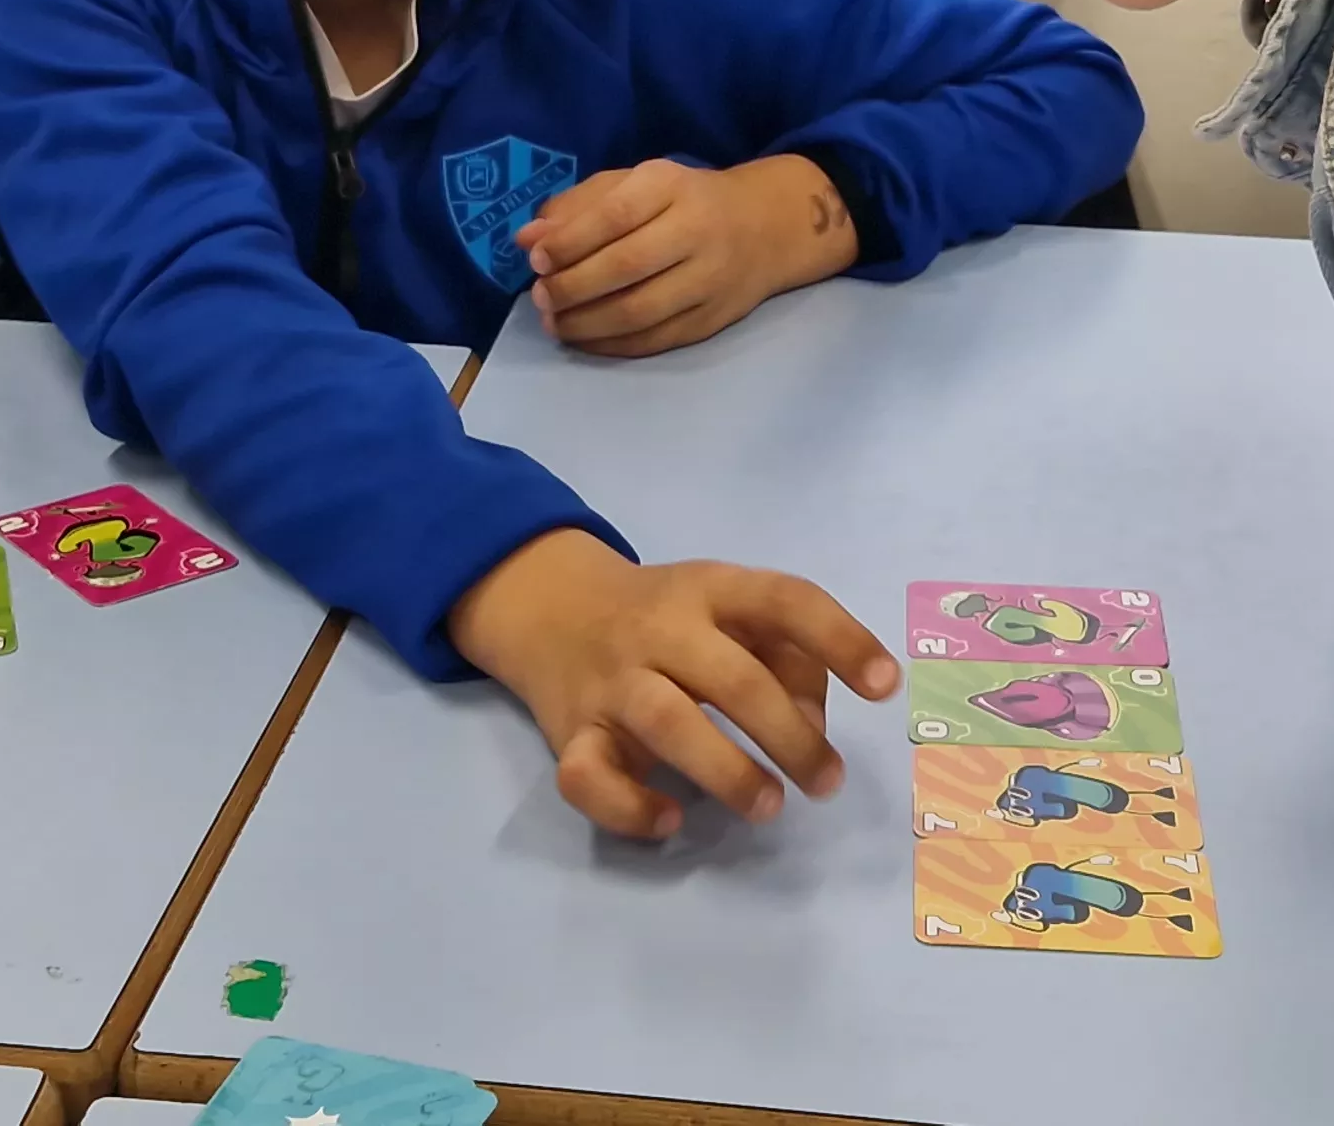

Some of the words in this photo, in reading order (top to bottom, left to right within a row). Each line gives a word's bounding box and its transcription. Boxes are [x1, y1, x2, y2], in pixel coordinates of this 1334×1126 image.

[1119, 588, 1150, 608] 2
[916, 637, 947, 655] 2
[1130, 668, 1163, 687] 0
[915, 719, 950, 739] 0
[1148, 756, 1183, 775] 7
[922, 811, 958, 832] 7
[1162, 853, 1201, 875] 7
[924, 915, 963, 937] 7
